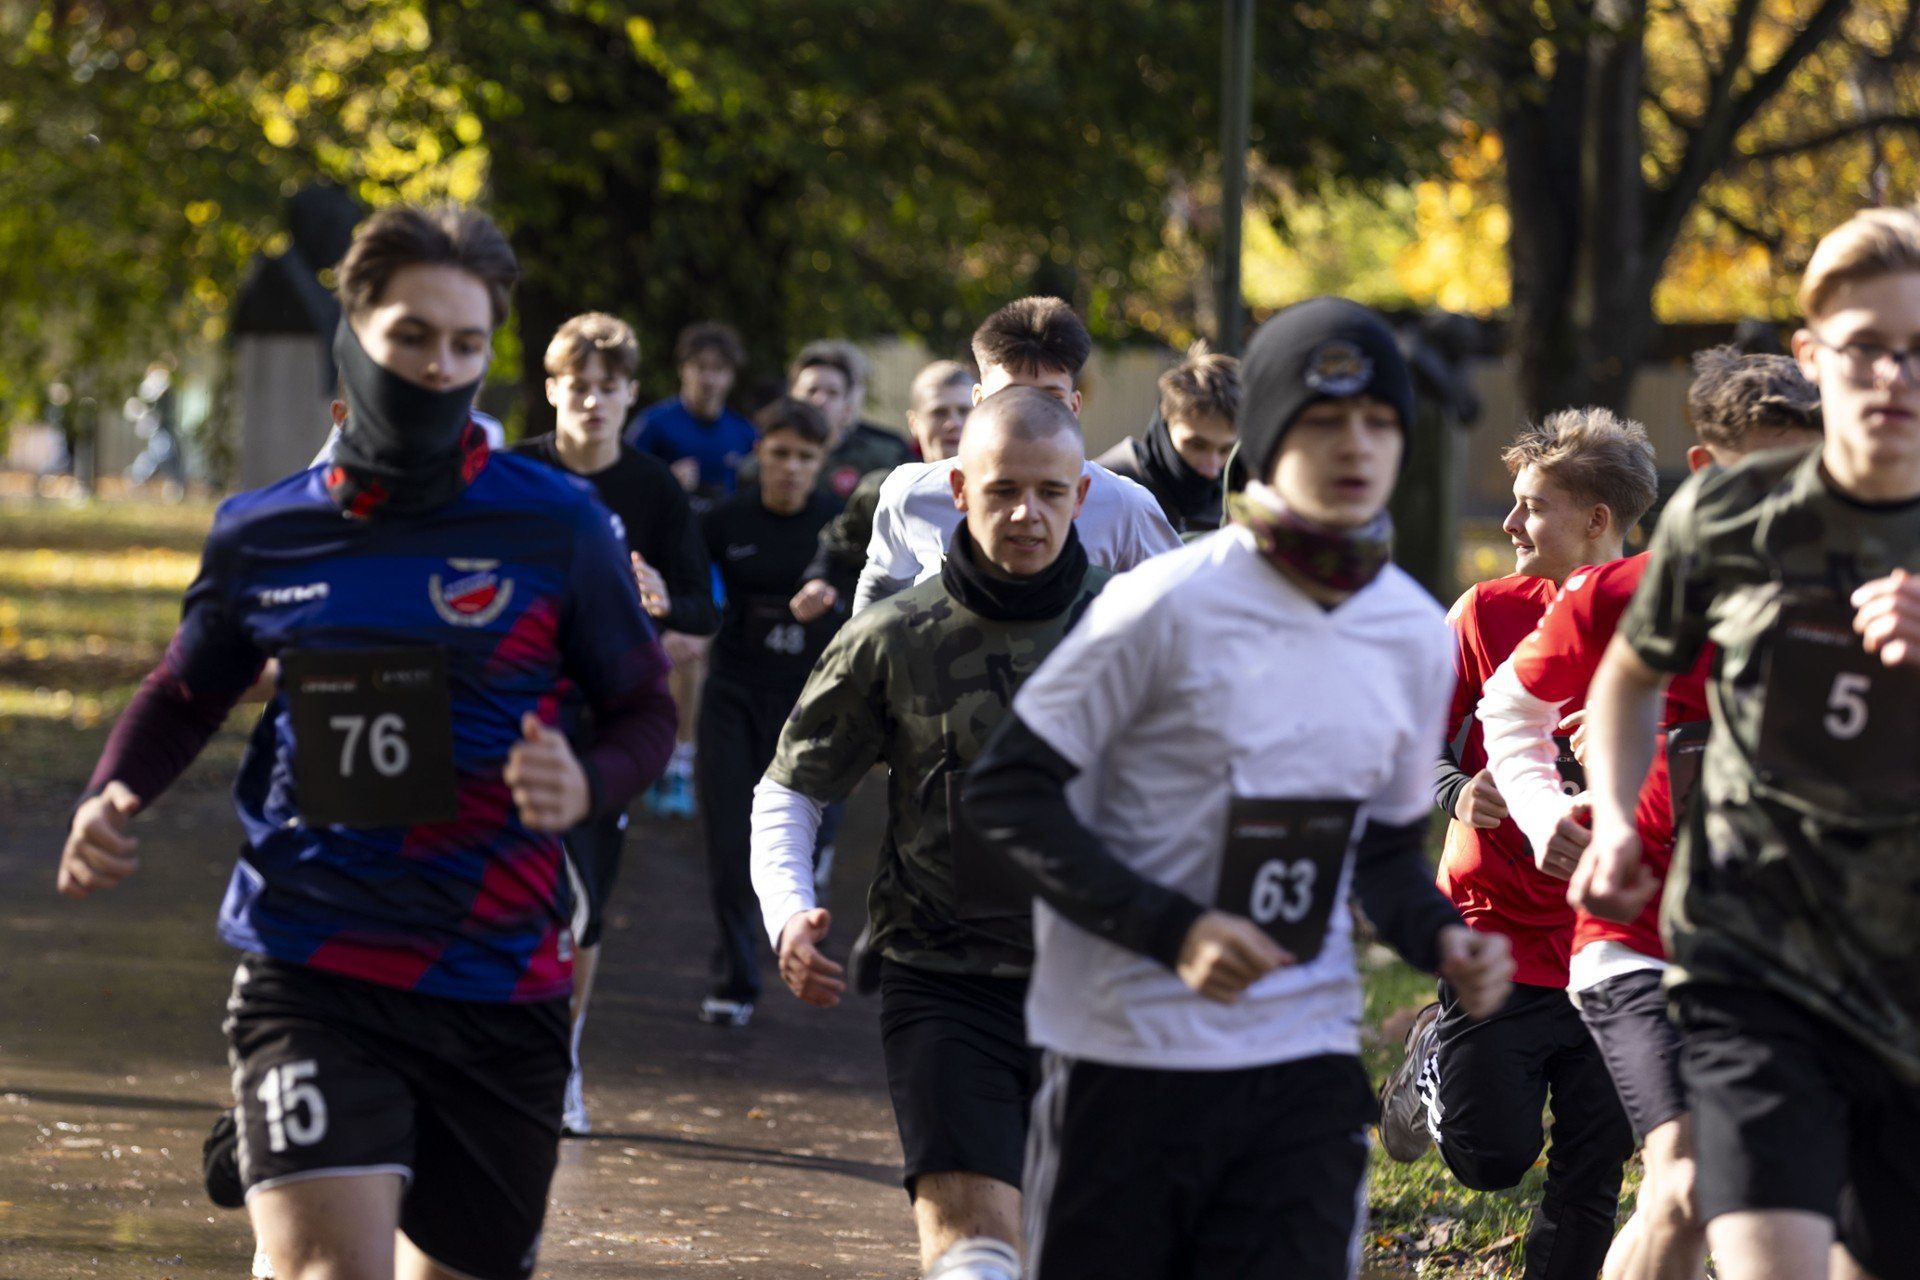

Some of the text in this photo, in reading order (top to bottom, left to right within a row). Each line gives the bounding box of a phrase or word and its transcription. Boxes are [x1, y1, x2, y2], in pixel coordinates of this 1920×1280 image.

[1823, 671, 1871, 740] 5
[330, 713, 410, 777] 76
[1250, 858, 1318, 923] 63
[257, 1059, 328, 1153] 15
